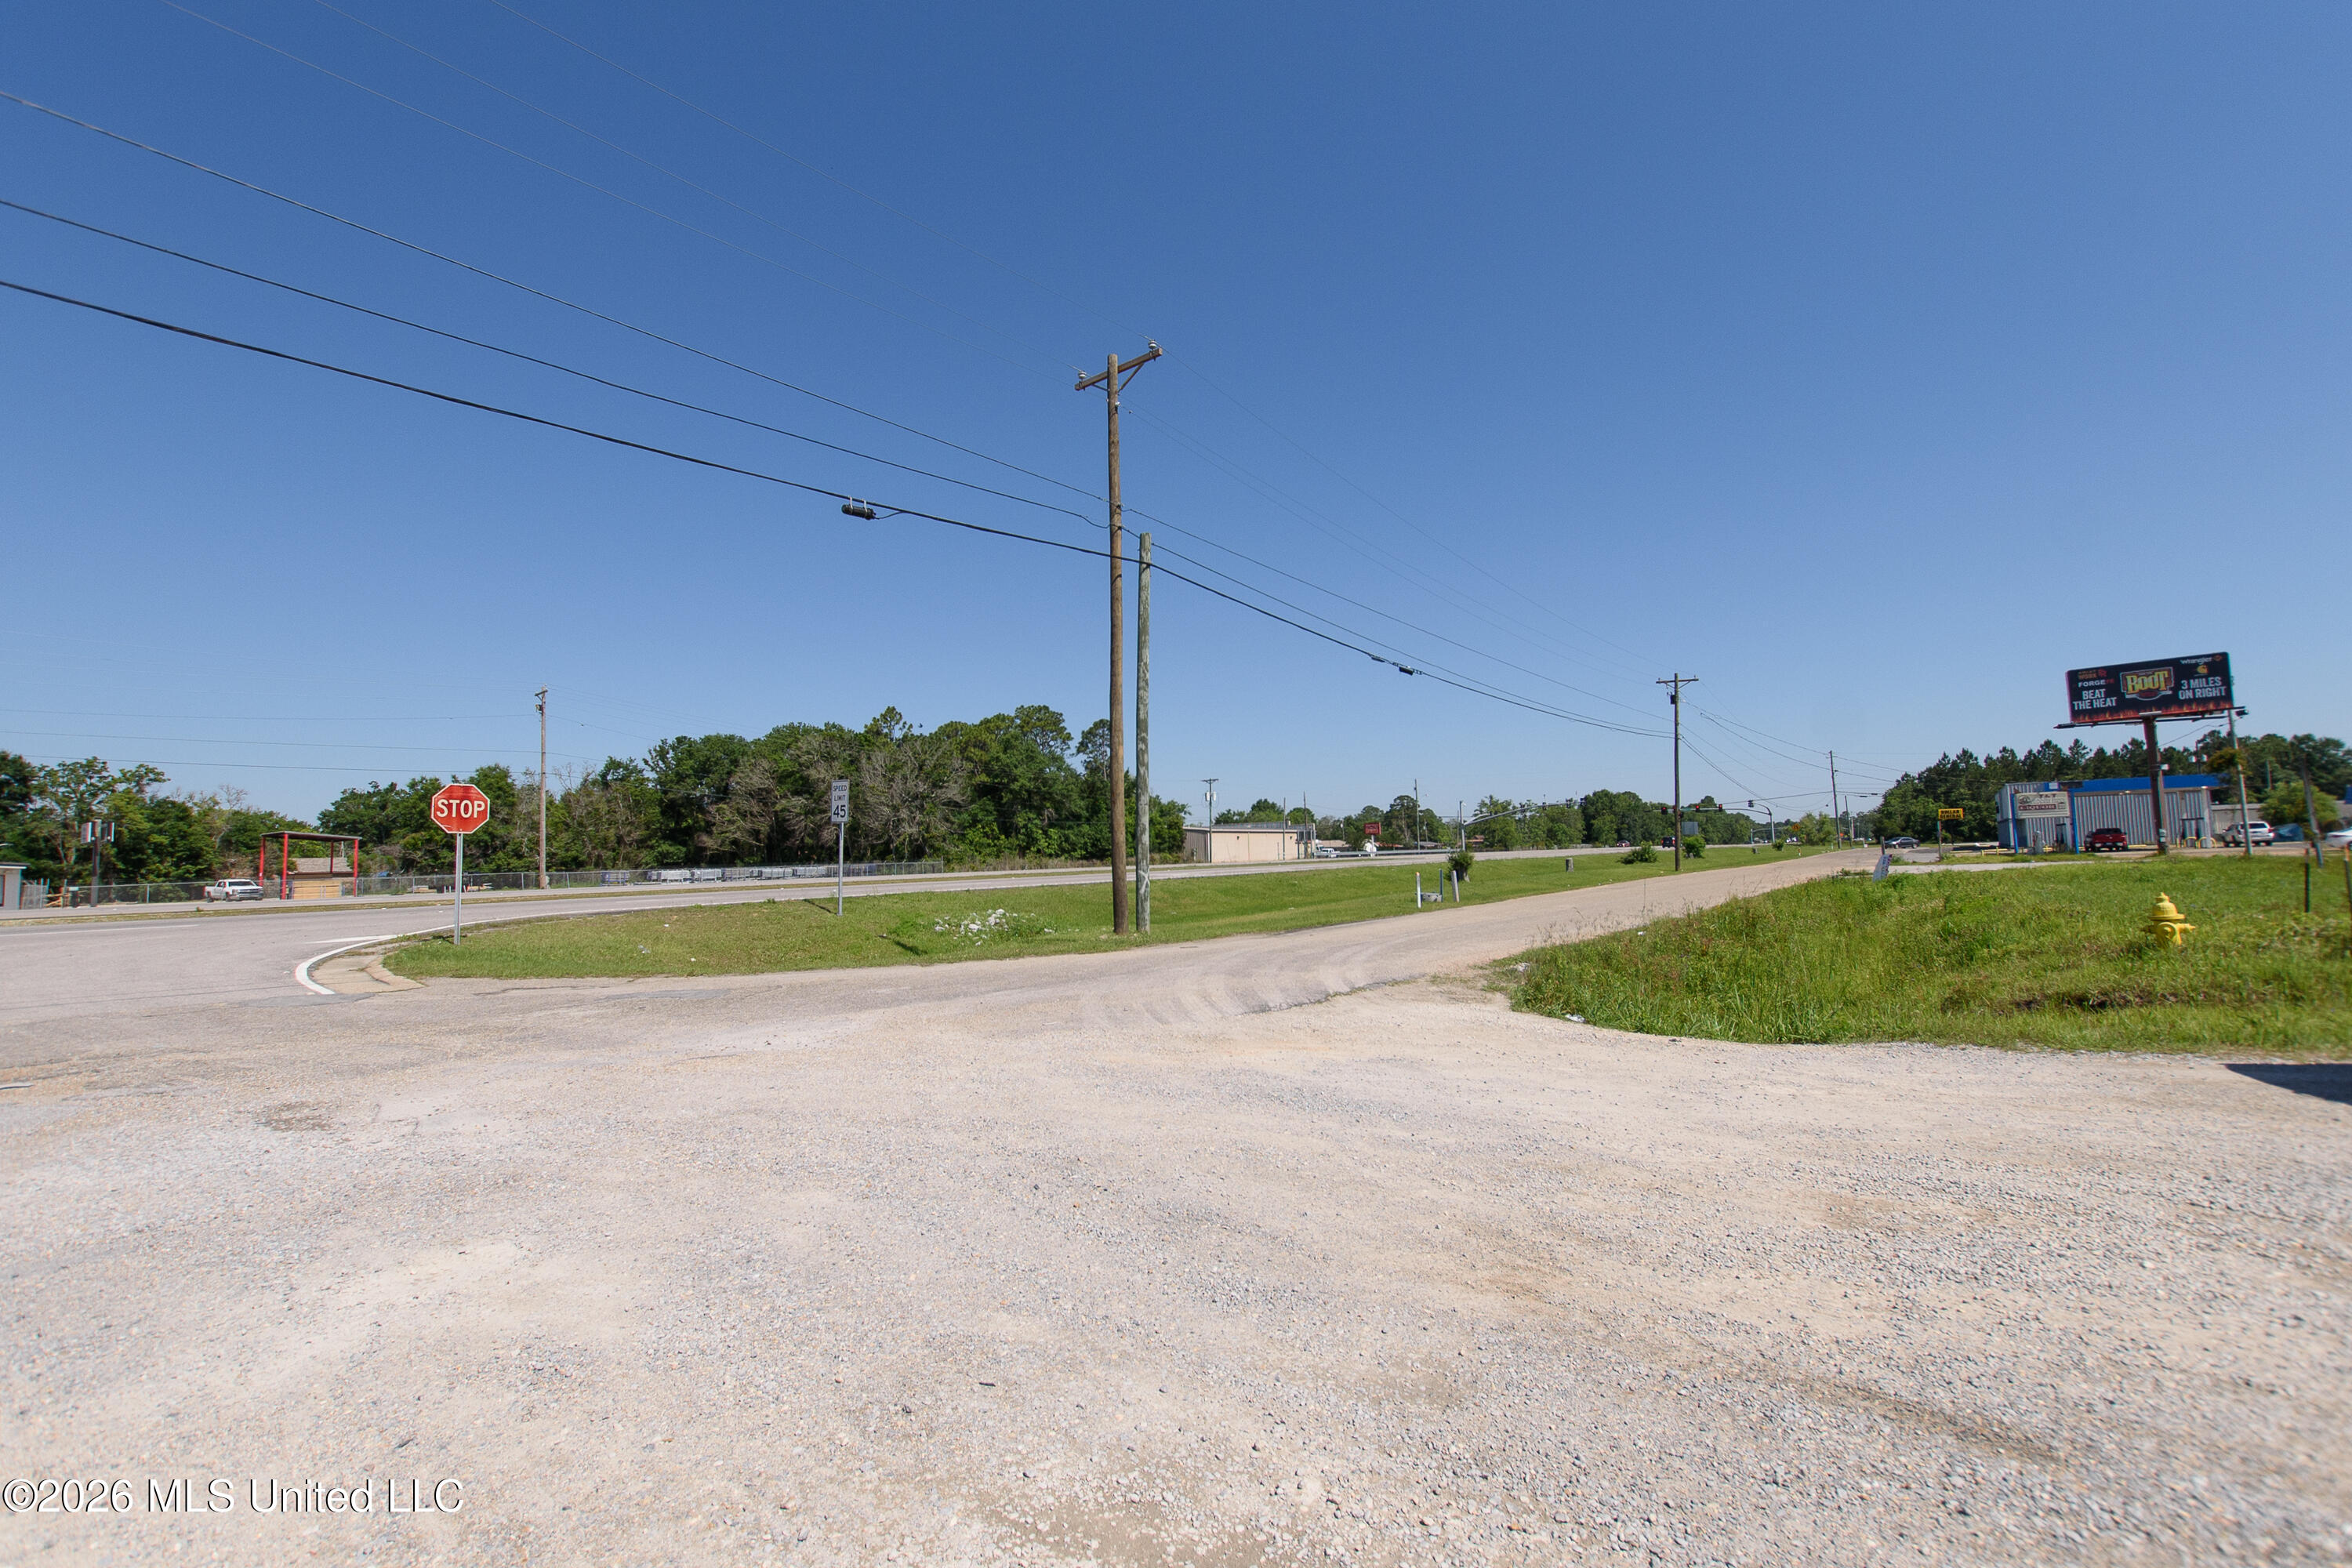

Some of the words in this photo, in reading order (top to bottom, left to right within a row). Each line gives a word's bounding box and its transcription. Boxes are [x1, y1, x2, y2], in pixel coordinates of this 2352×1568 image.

[2125, 670, 2169, 694] BOOT
[2181, 680, 2188, 689] 3
[2190, 676, 2222, 689] MILES
[2082, 688, 2106, 700] BEAT
[2178, 690, 2194, 700] ON
[2195, 686, 2227, 699] RIGHT
[2072, 699, 2092, 710] THE
[2092, 697, 2117, 709] HEAT
[436, 798, 485, 818] STOP
[833, 804, 846, 818] 45
